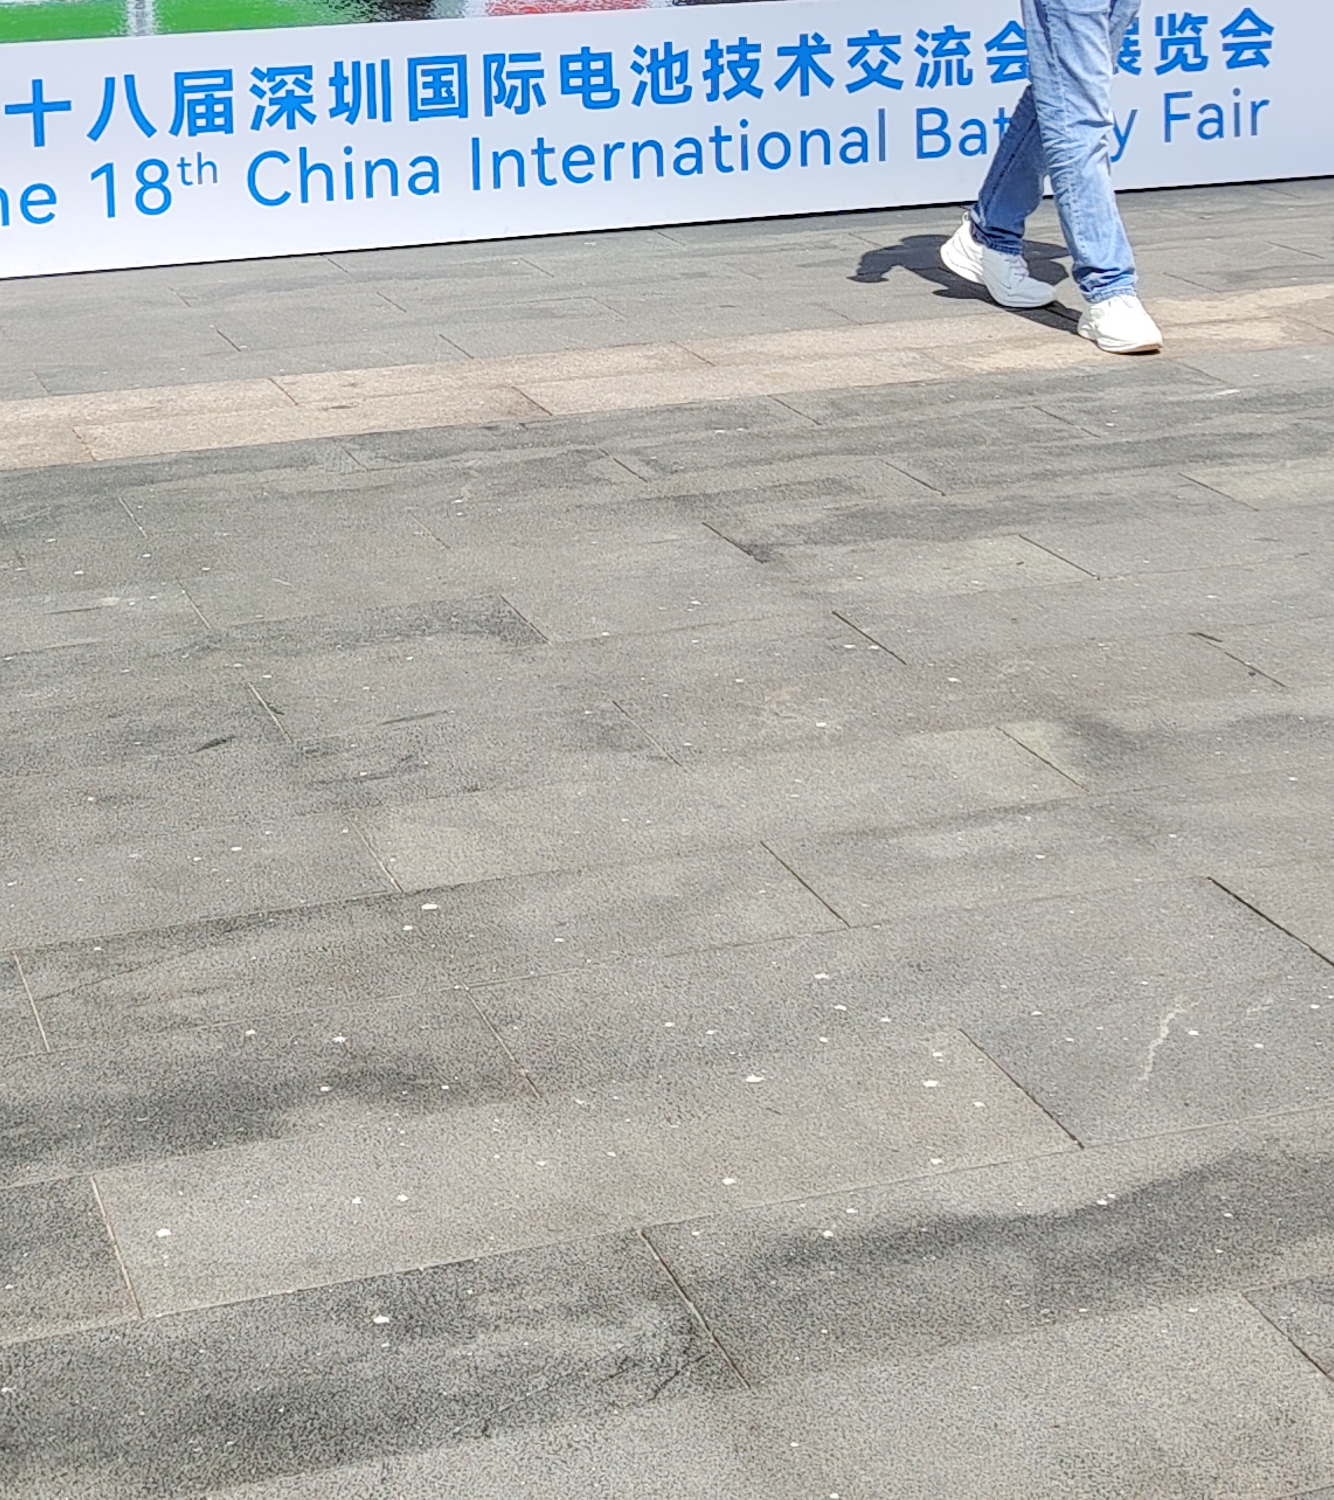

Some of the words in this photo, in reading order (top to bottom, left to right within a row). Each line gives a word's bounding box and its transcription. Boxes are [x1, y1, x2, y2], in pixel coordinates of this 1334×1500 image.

[89, 151, 219, 219] 18th
[246, 144, 441, 207] China
[470, 107, 887, 192] International
[914, 106, 1140, 163] Baty
[1162, 87, 1272, 144] Fair
